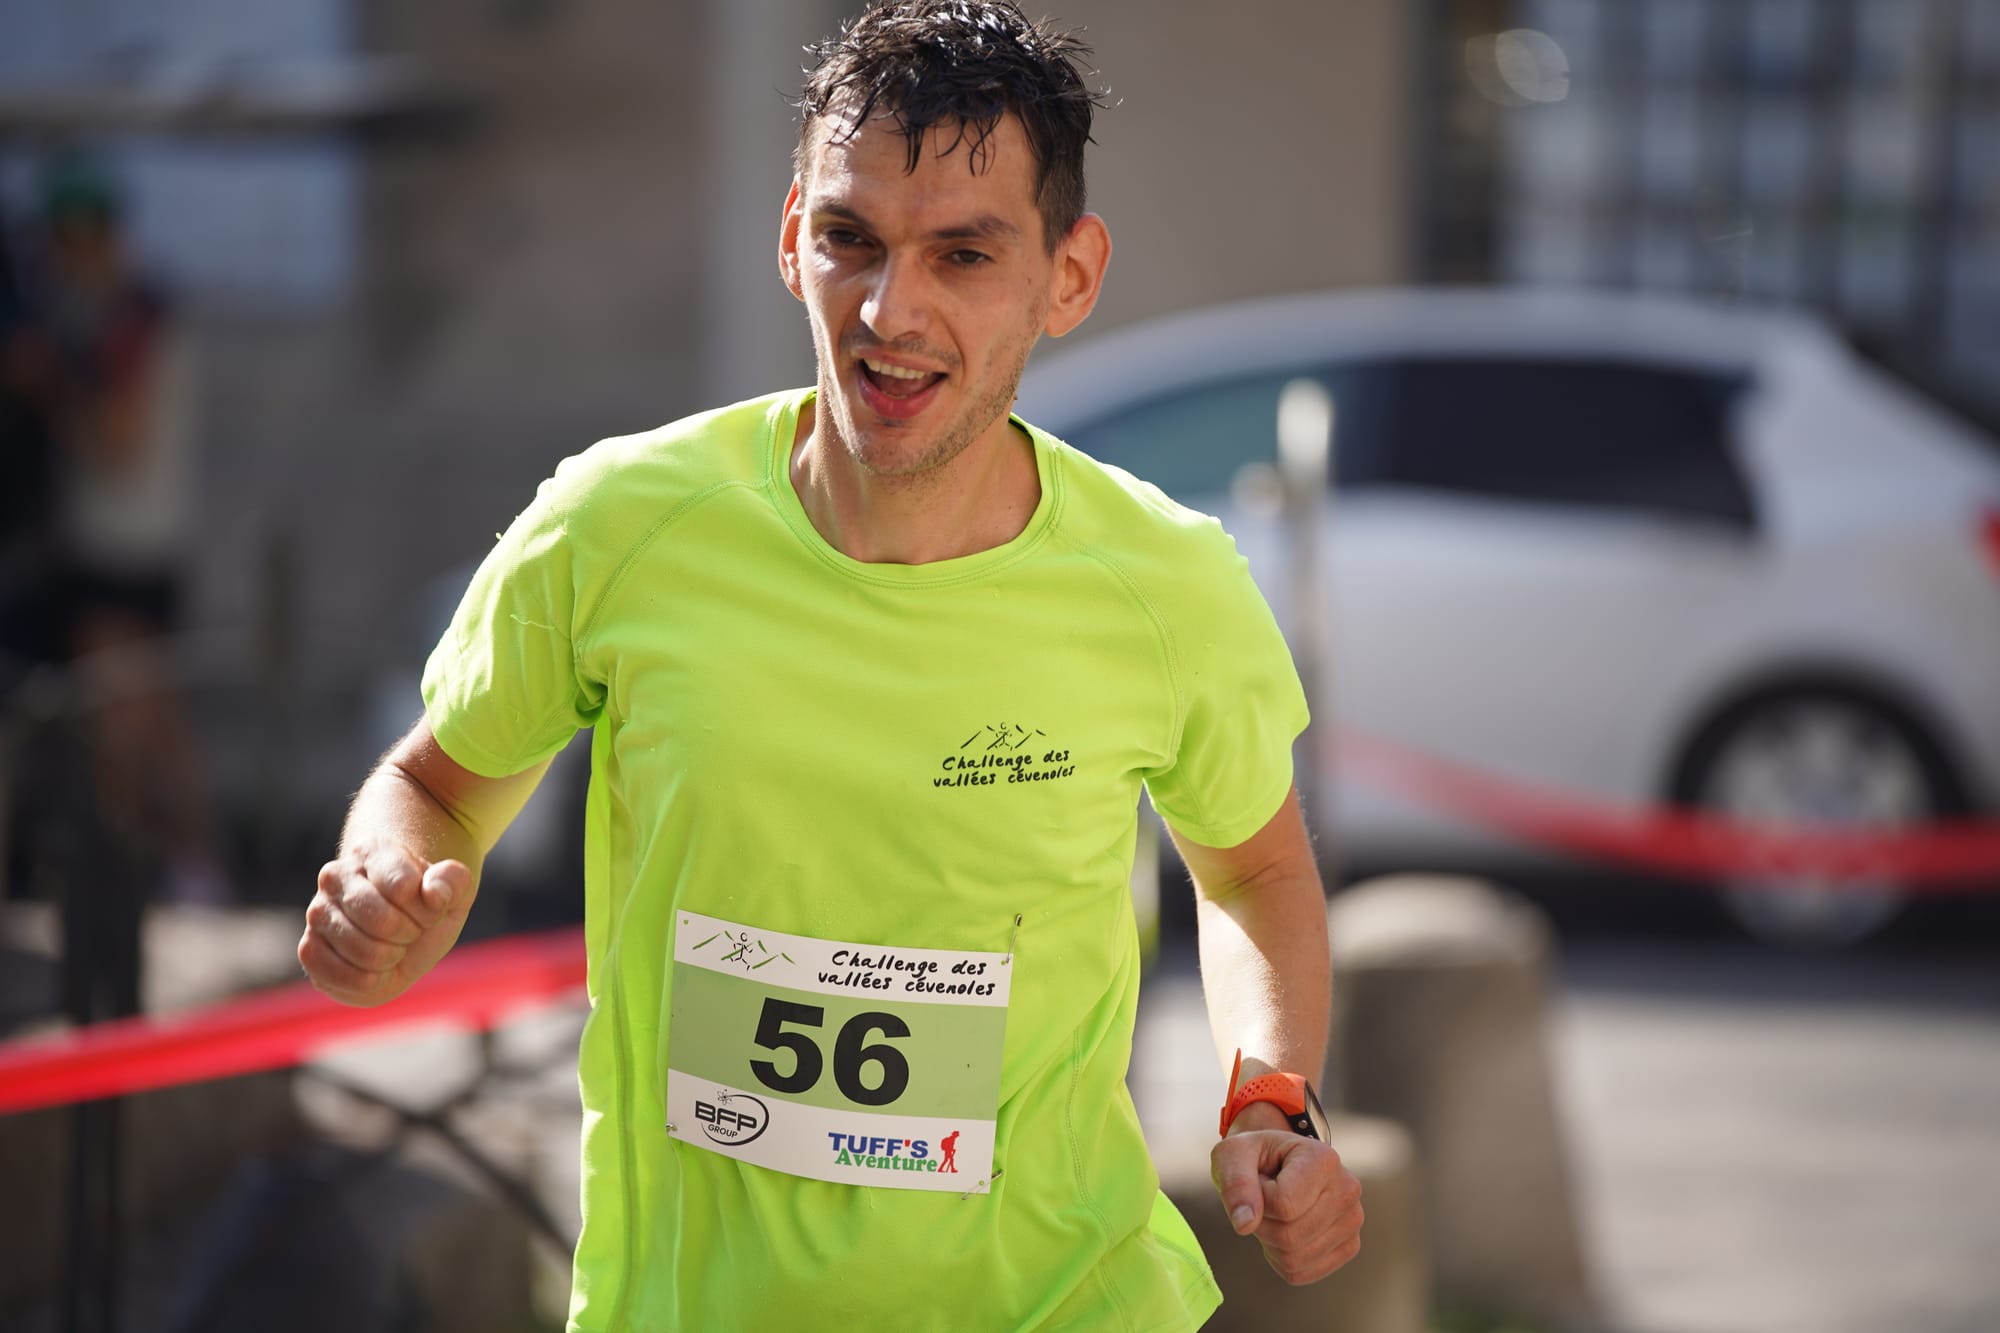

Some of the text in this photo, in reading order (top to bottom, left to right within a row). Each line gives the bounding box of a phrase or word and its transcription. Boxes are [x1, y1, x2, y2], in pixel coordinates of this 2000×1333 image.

[942, 750, 1070, 771] Challenge des
[933, 765, 1075, 787] vallées cévenoles
[831, 950, 987, 976] Challenge des
[818, 971, 996, 997] vallées cévenoles
[749, 997, 911, 1106] 56
[695, 1100, 757, 1131] BFP
[707, 1123, 738, 1138] GROUP
[828, 1132, 928, 1158] TUFF'S
[835, 1148, 938, 1172] Aventure
